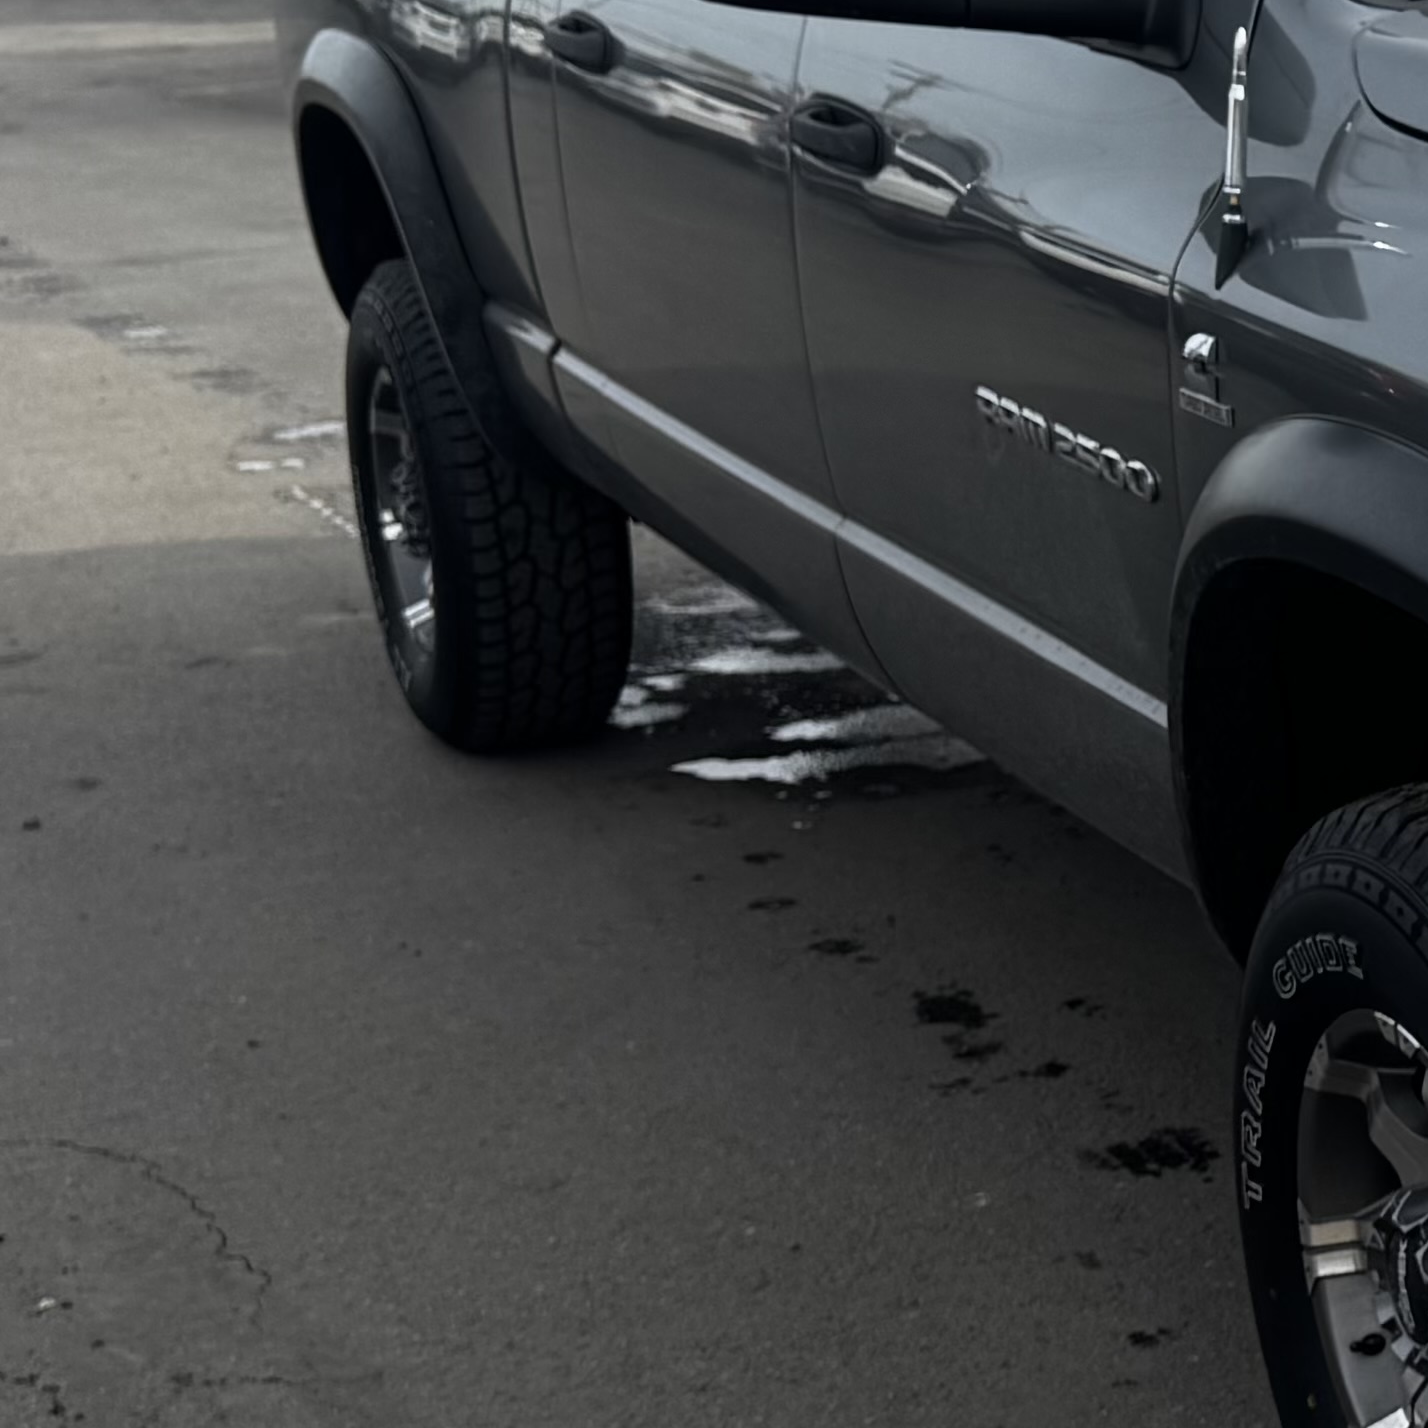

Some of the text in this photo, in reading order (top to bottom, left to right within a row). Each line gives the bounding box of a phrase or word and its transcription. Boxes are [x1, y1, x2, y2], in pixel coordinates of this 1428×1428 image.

[1053, 421, 1161, 504] 2500
[1240, 932, 1364, 1211] TRAIL GUIDE
